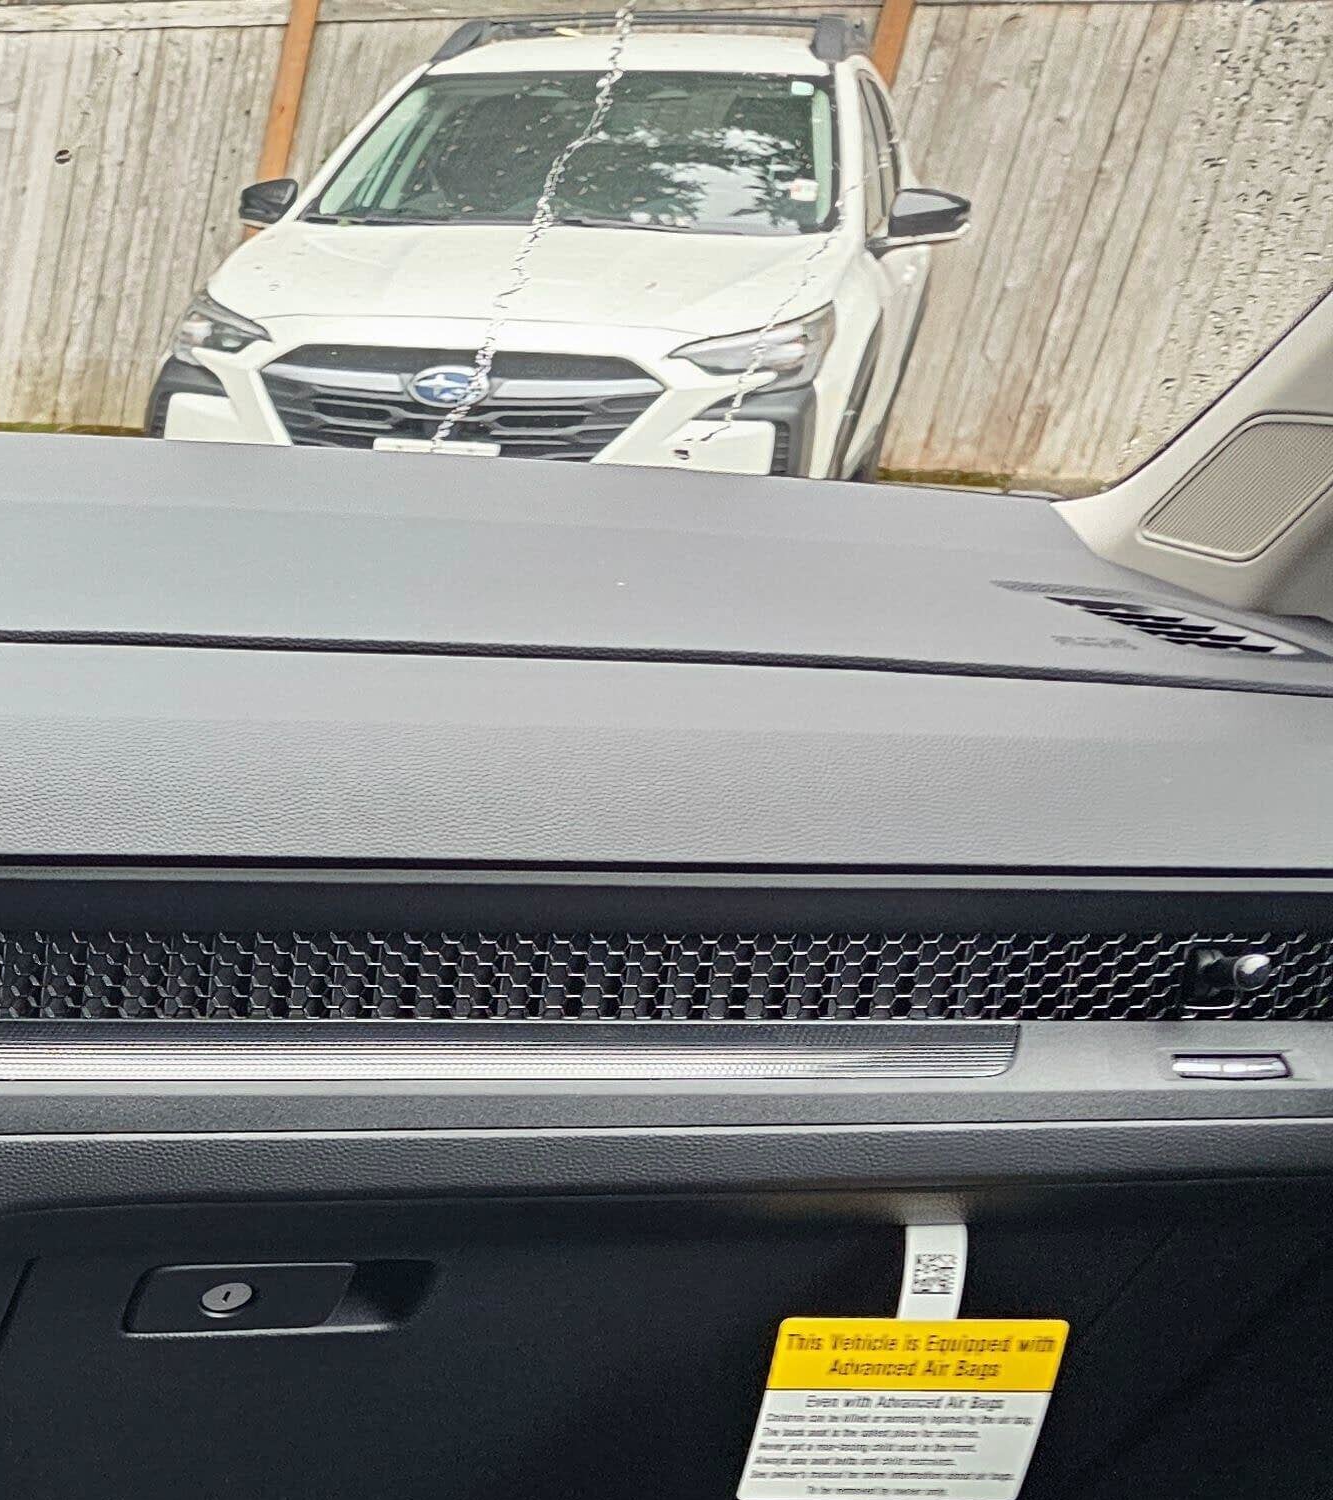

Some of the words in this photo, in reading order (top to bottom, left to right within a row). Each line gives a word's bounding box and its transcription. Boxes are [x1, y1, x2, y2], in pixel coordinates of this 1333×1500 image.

[786, 1334, 823, 1351] This
[832, 1335, 898, 1351] Vehicle
[903, 1335, 919, 1351] is
[925, 1335, 1011, 1354] Equipped
[1018, 1336, 1055, 1352] with
[828, 1360, 918, 1377] Advanced
[922, 1360, 949, 1377] Air
[954, 1360, 1001, 1380] Bags
